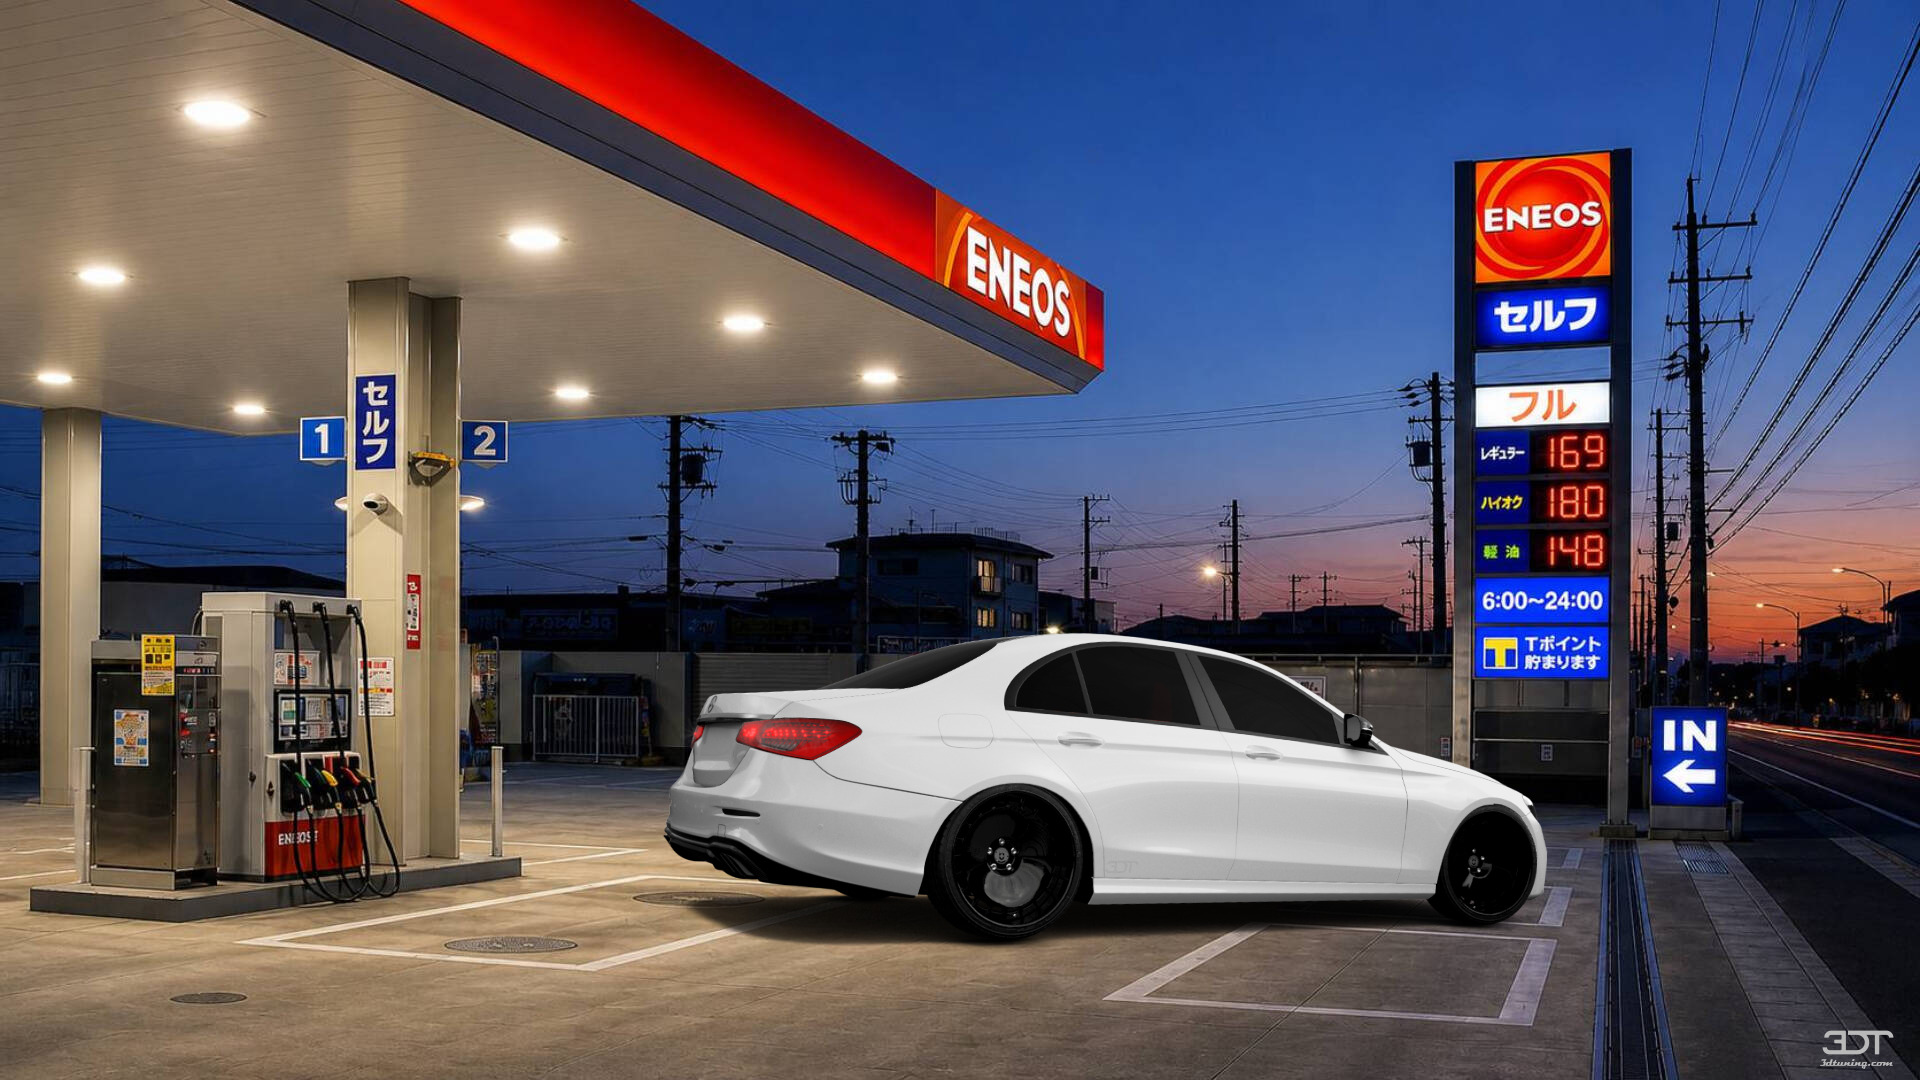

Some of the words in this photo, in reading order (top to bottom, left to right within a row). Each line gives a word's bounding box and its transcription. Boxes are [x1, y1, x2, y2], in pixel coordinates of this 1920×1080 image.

[1484, 201, 1602, 233] ENEOS
[967, 225, 1071, 337] ENEOS
[1493, 297, 1597, 333] セルフ
[1509, 388, 1577, 423] フル
[362, 380, 389, 464] セルフ
[314, 423, 329, 454] 1
[473, 425, 496, 456] 2
[1481, 445, 1525, 461] レギュラー
[1549, 435, 1604, 468] 169
[1480, 495, 1524, 510] ハイオク
[1549, 485, 1604, 518] 180
[1549, 535, 1604, 567] 148
[1524, 635, 1601, 652] Tポイント
[1524, 654, 1601, 670] 貯まります
[1663, 719, 1717, 751] IN
